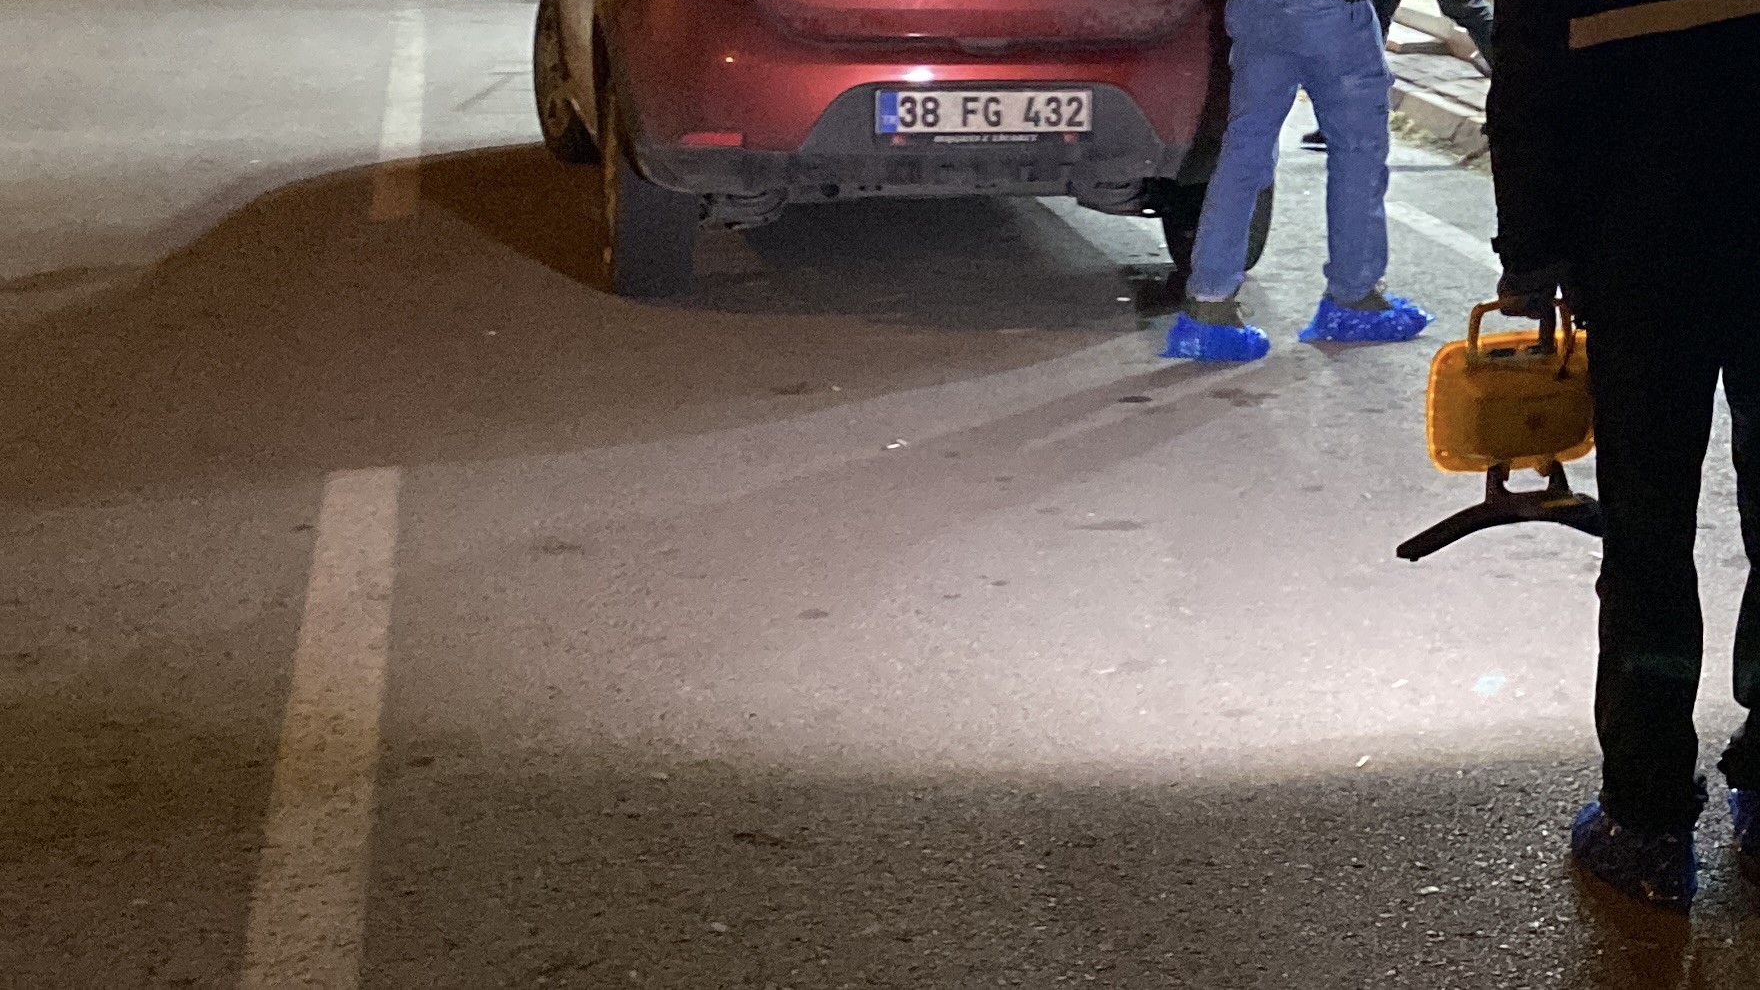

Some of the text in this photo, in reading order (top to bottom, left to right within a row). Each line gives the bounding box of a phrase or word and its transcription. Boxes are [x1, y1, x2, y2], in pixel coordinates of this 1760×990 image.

[900, 96, 1085, 128] 38 FG 432
